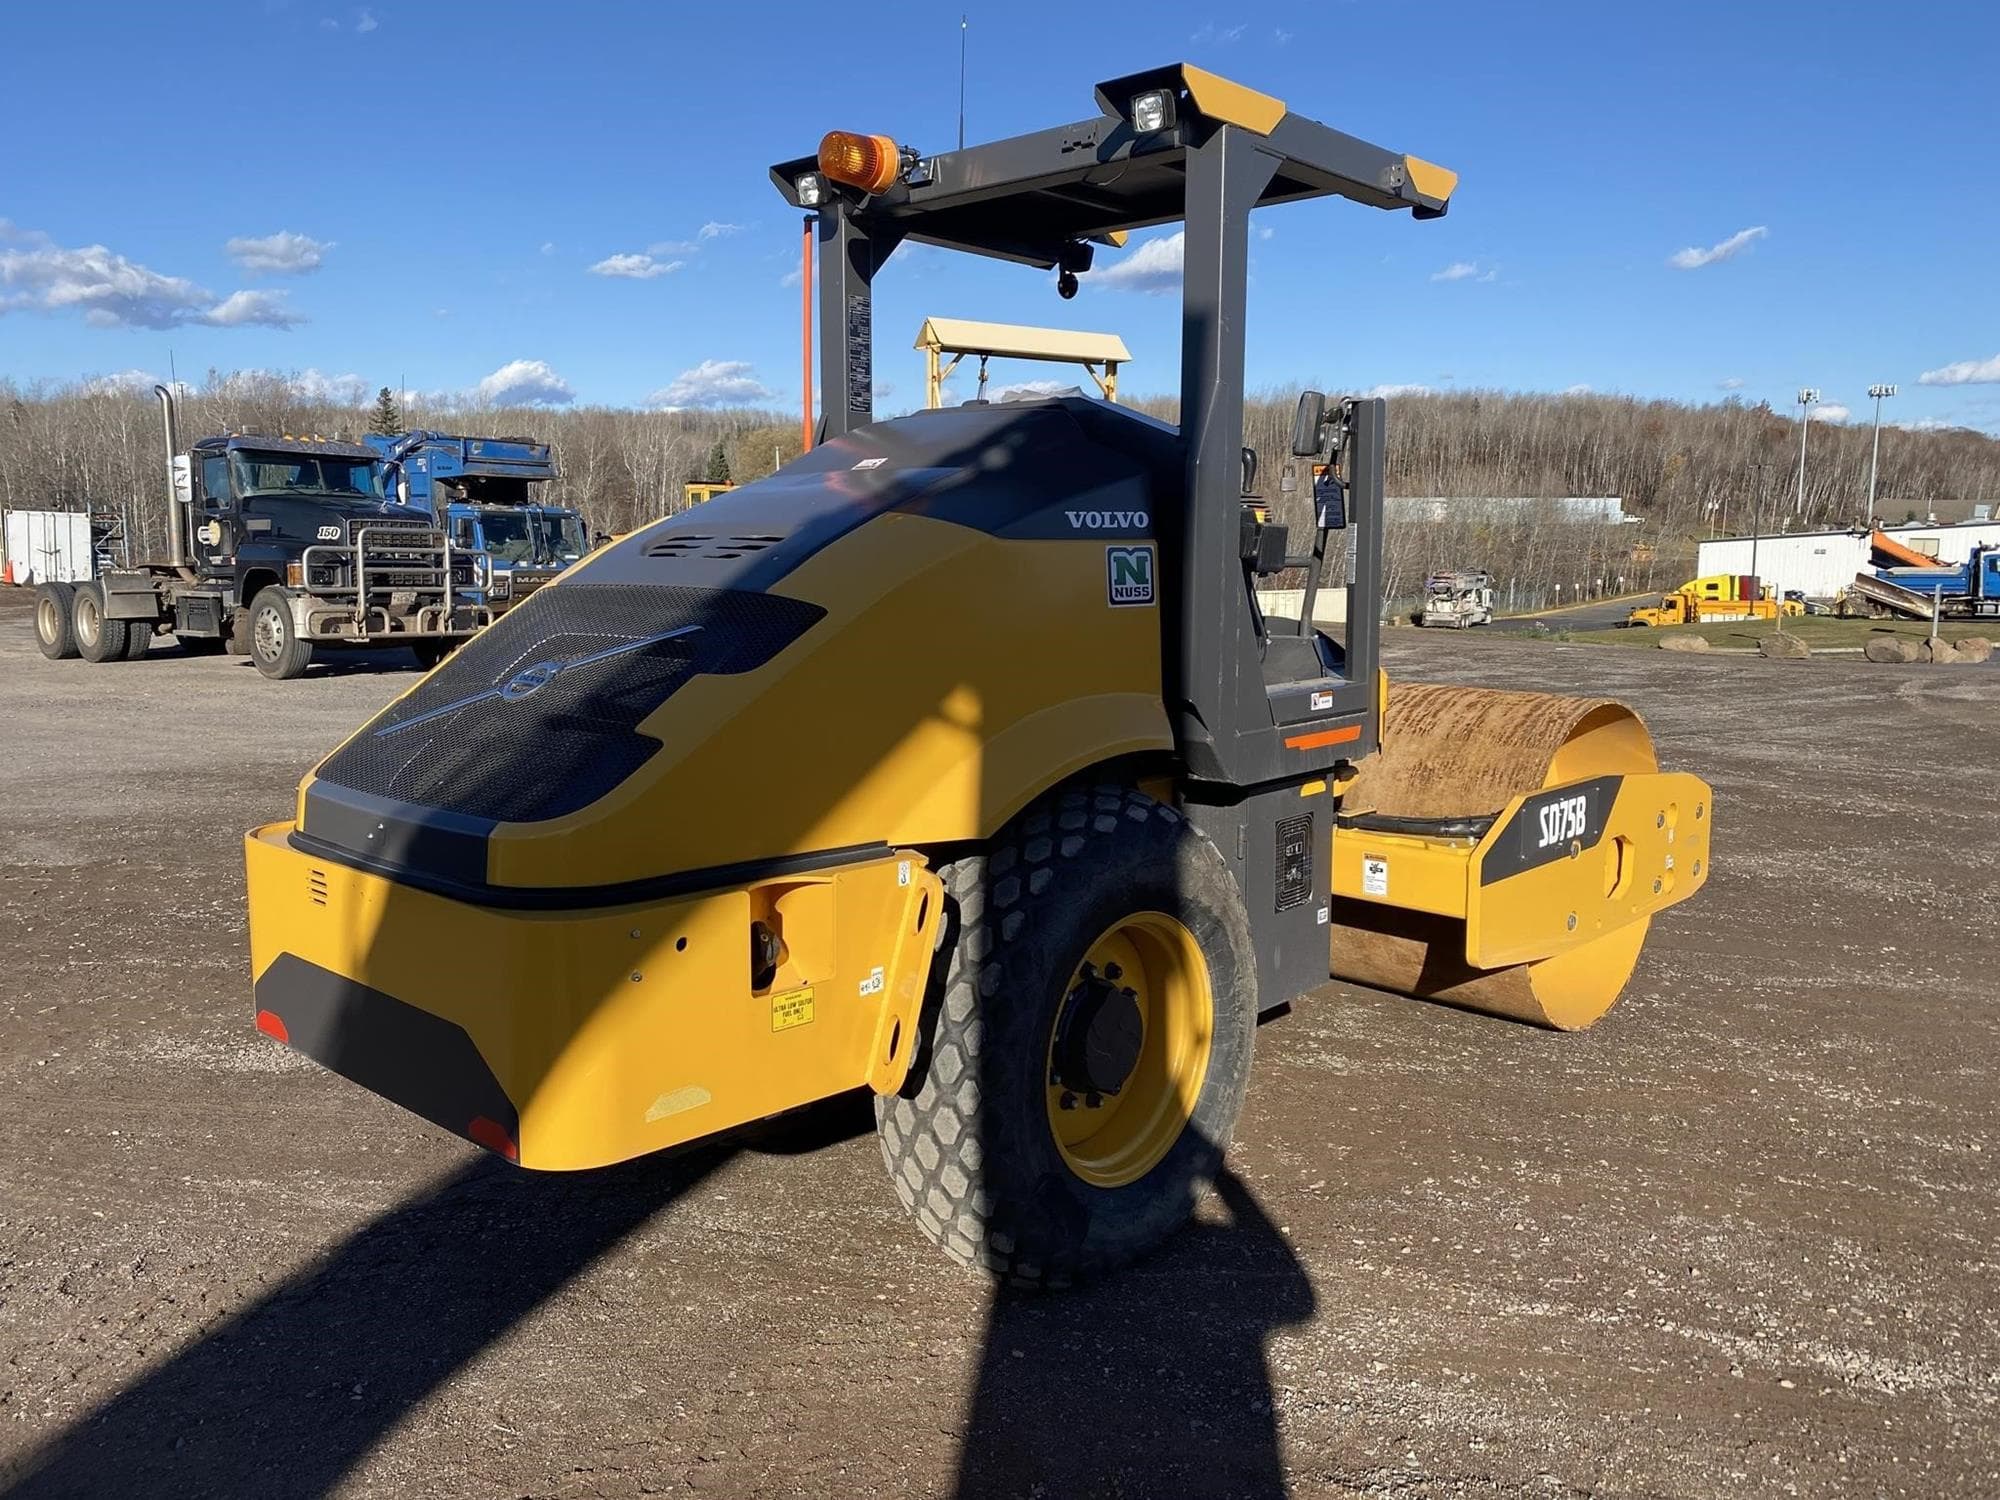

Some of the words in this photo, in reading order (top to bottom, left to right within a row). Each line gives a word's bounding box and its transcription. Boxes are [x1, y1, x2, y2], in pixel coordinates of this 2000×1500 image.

[1064, 511, 1150, 528] VOLVO
[318, 527, 339, 538] 150
[1112, 555, 1150, 586] N
[1114, 586, 1150, 598] NUSS
[1539, 795, 1586, 848] SD75B
